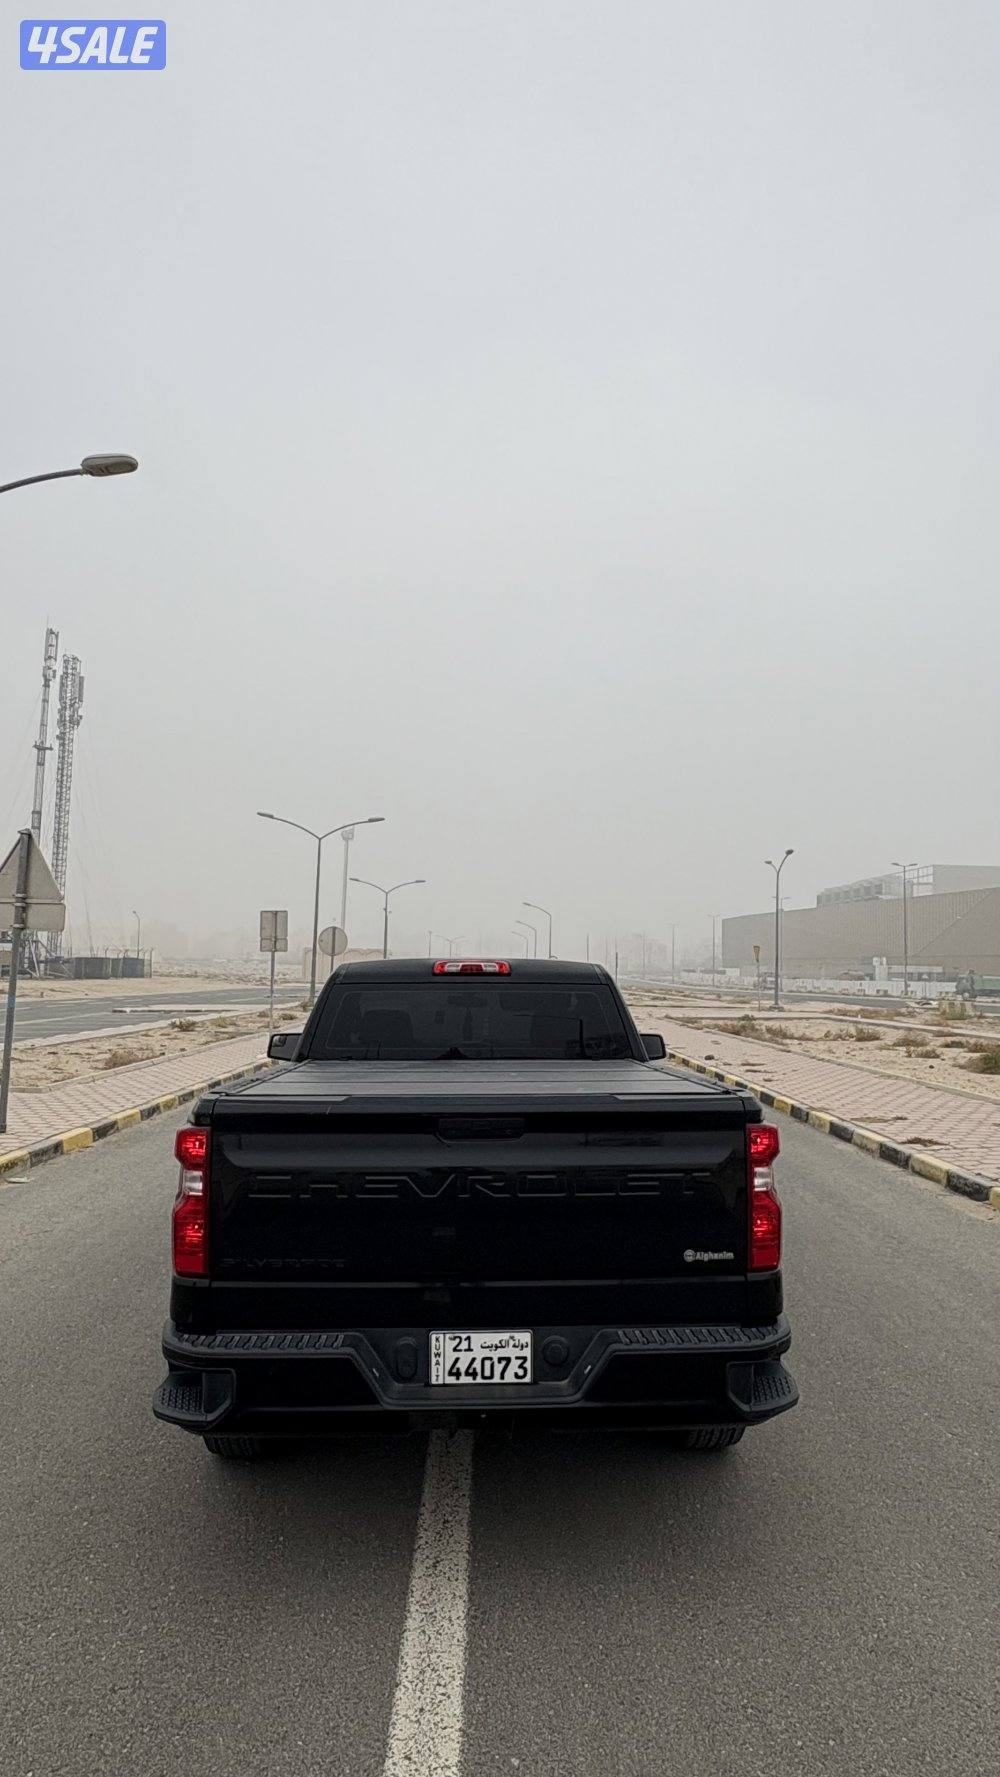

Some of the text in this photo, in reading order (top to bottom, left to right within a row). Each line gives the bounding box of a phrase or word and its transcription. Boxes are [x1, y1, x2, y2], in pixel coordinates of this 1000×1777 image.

[248, 1171, 711, 1198] CHEVROLET
[452, 1335, 474, 1352] 21
[480, 1338, 529, 1351] دولة الكويت
[433, 1336, 441, 1382] KUWAIT
[447, 1356, 528, 1381] 44073
